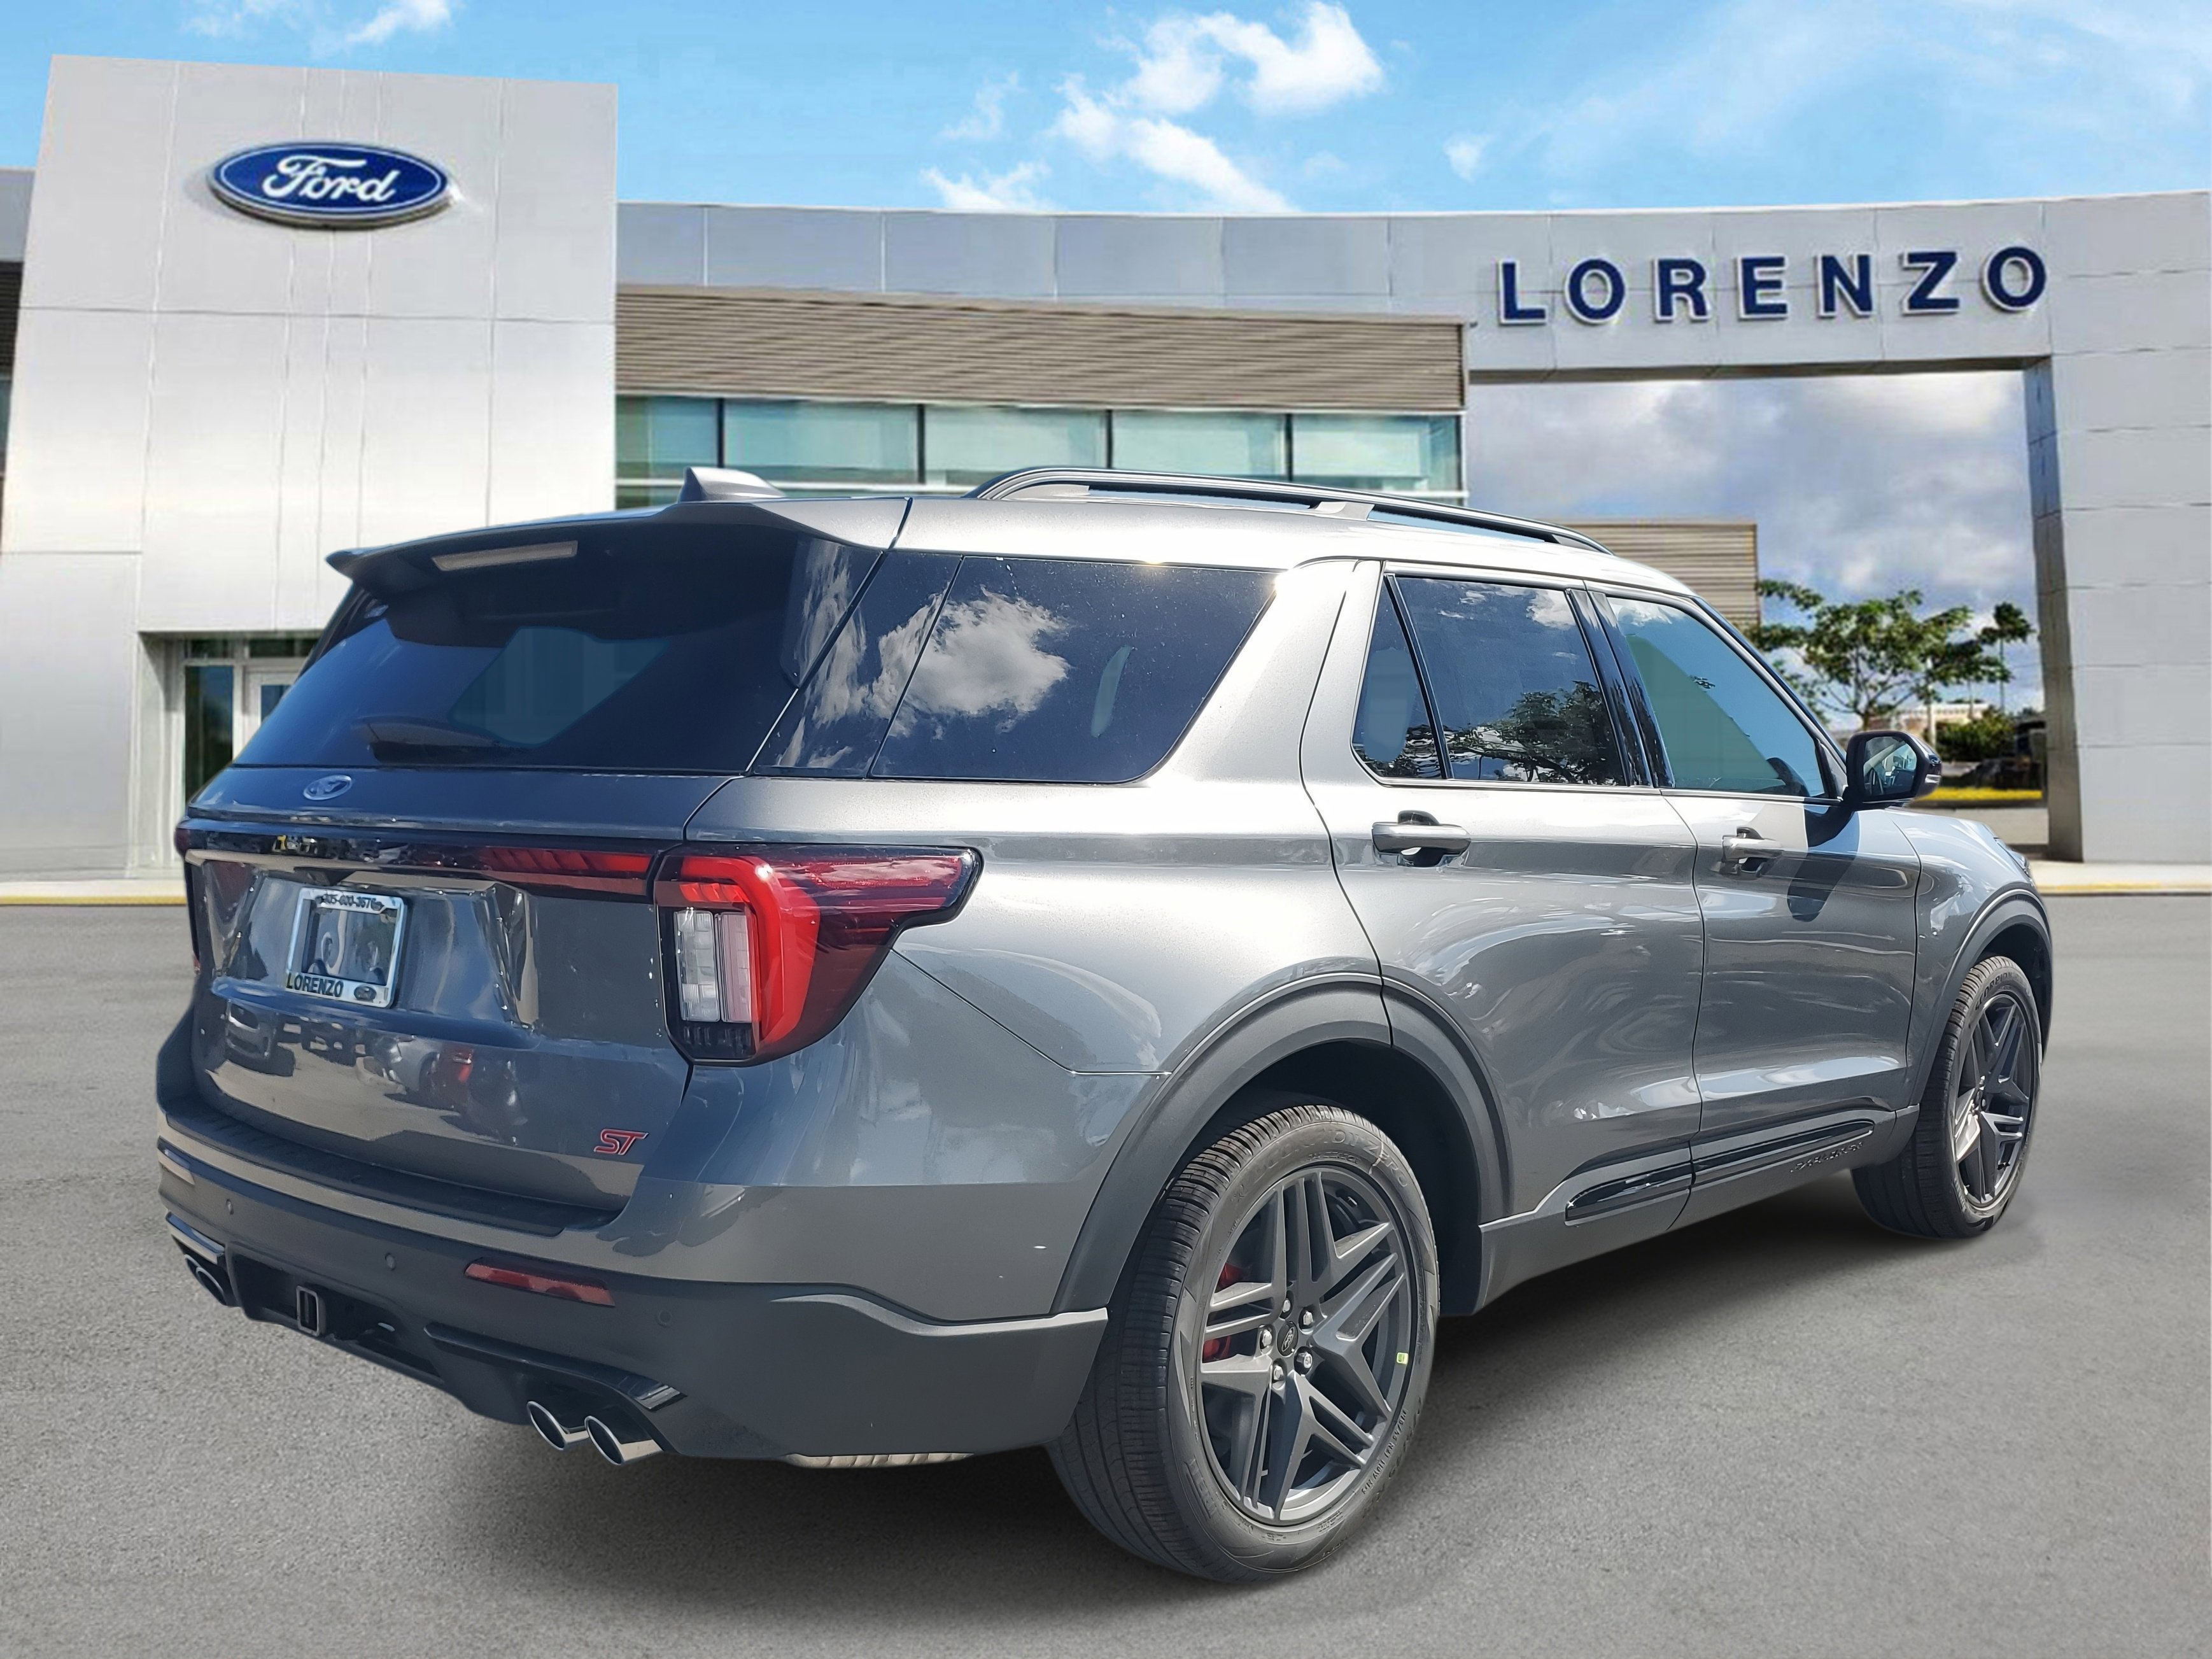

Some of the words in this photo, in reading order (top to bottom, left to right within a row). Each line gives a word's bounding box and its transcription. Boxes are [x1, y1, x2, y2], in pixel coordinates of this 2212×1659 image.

[262, 155, 400, 202] Ford
[1499, 246, 2046, 325] LORENZO
[287, 973, 344, 997] LORENZO
[593, 1128, 649, 1155] ST
